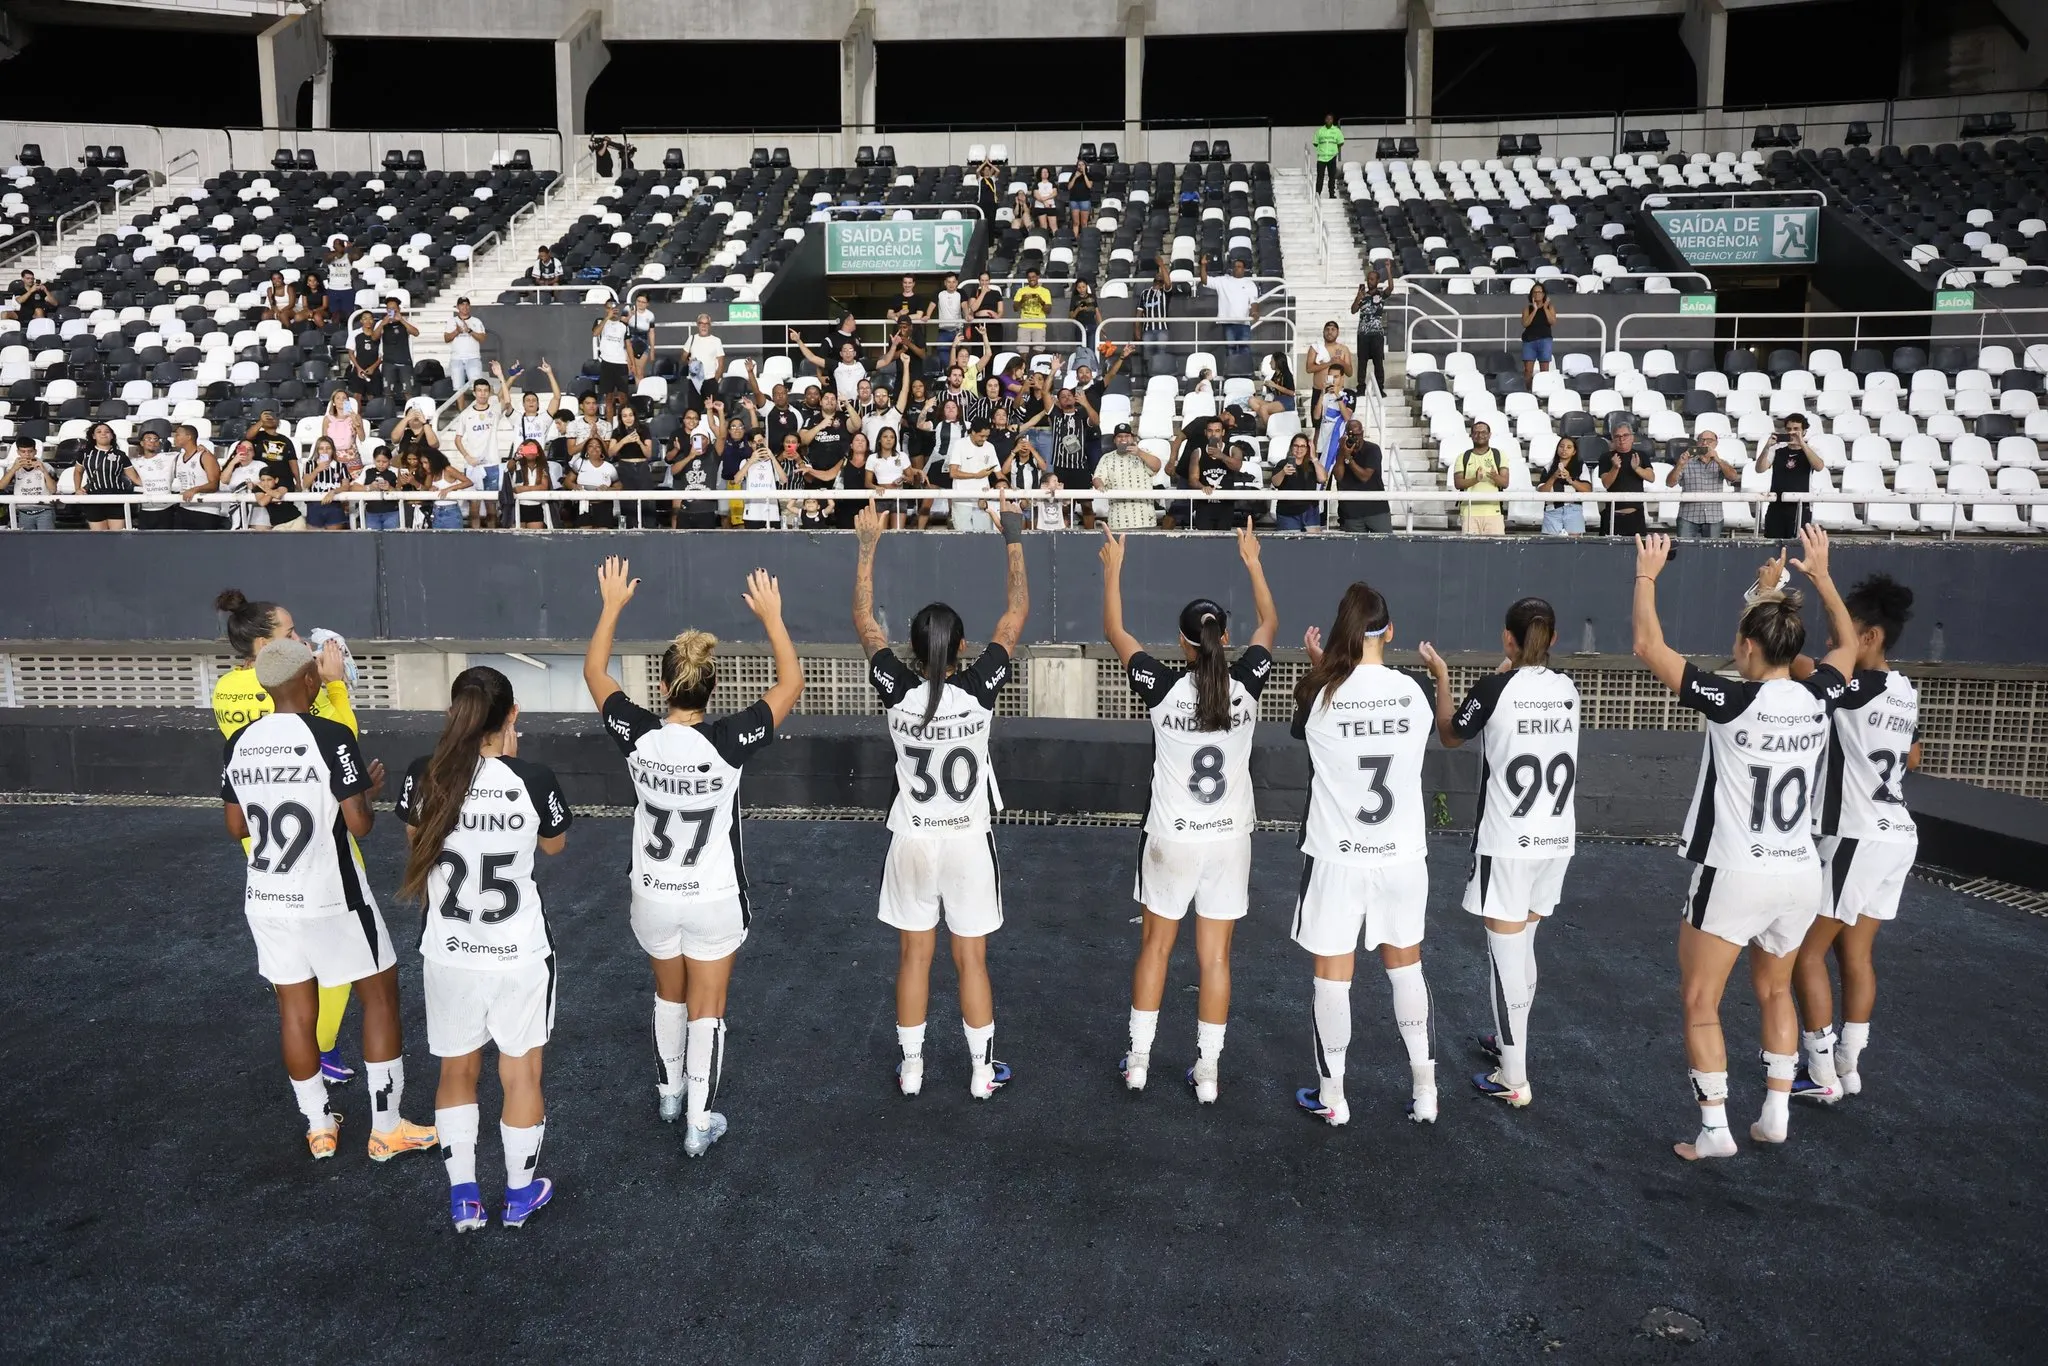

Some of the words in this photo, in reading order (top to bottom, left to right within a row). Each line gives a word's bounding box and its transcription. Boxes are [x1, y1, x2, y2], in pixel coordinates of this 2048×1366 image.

[841, 224, 894, 243] SAÍDA
[898, 228, 922, 242] DE
[1669, 214, 1727, 234] SAÍDA
[1733, 217, 1760, 232] DE
[841, 242, 922, 257] EMERGÊNCIA
[1681, 251, 1734, 261] ERGENCY
[1735, 251, 1758, 260] EXIT
[841, 259, 900, 269] EMERGENCY
[903, 259, 923, 268] EXIT
[1682, 301, 1713, 311] SAÍDA
[1938, 297, 1972, 307] SAÍDA
[877, 671, 895, 694] bmg
[1135, 671, 1156, 690] bmg
[215, 692, 254, 703] tecnogera
[1332, 697, 1397, 711] tecnogera
[1514, 700, 1563, 711] tecnogera
[1463, 698, 1482, 722] bmg
[1757, 711, 1811, 727] tecnogera
[1868, 711, 1884, 728] GI
[1161, 708, 1252, 732] ANDSA
[1337, 718, 1410, 738] TELES
[1517, 717, 1574, 736] ERIKA
[1735, 729, 1753, 749] G.
[239, 744, 292, 757] tecnogera
[338, 760, 358, 787] bmg
[637, 756, 696, 776] tecnogera
[903, 744, 980, 804] 30
[1187, 744, 1228, 806] 8
[231, 765, 322, 787] RHAIZZA
[630, 764, 725, 796] TAMIRES
[1505, 752, 1576, 818] 99
[1355, 754, 1396, 826] 3
[1747, 763, 1808, 835] 10
[550, 797, 564, 827] bmg
[924, 814, 970, 828] Remessa
[643, 799, 718, 868] 37
[1189, 817, 1234, 832] Remessa
[246, 799, 316, 875] 29
[1534, 836, 1569, 847] Remessa
[433, 848, 521, 925] 25
[653, 879, 700, 891] Remessa
[254, 889, 305, 902] Remessa
[461, 941, 518, 955] Remessa
[497, 954, 519, 962] Online
[1399, 1020, 1423, 1028] SCCP
